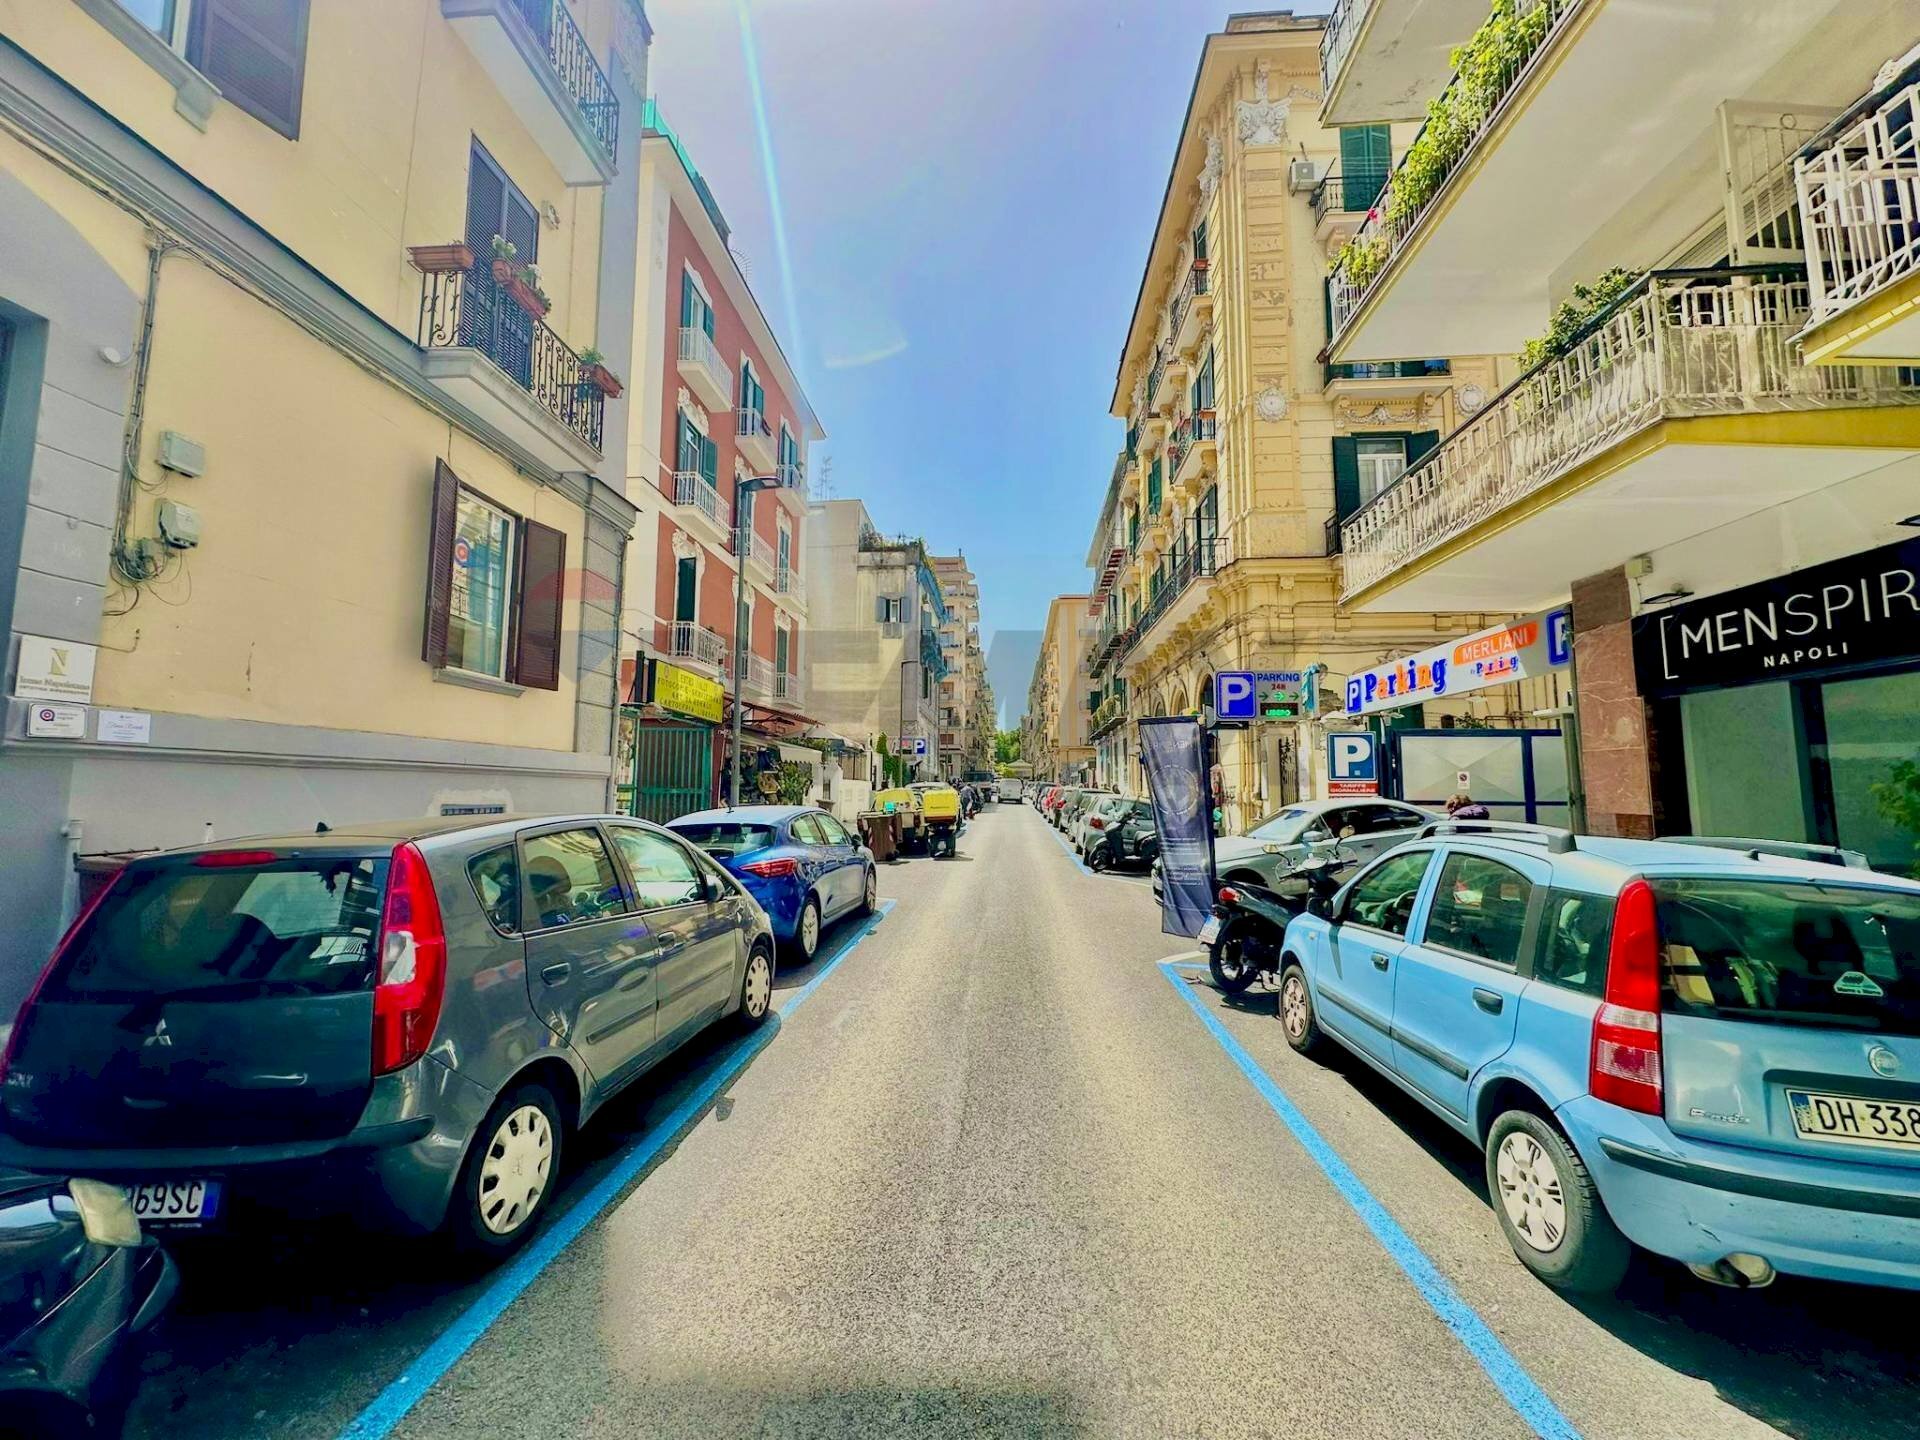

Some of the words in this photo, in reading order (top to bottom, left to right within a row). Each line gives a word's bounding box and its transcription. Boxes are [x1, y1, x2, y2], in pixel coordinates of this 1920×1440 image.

[1462, 627, 1529, 661] MERLIANI
[1763, 642, 1848, 667] NAPOLI
[48, 647, 71, 676] N
[1257, 673, 1300, 682] PARKING
[1364, 657, 1448, 703] Parking
[1221, 677, 1251, 714] P
[914, 739, 925, 754] P
[1334, 736, 1371, 777] P
